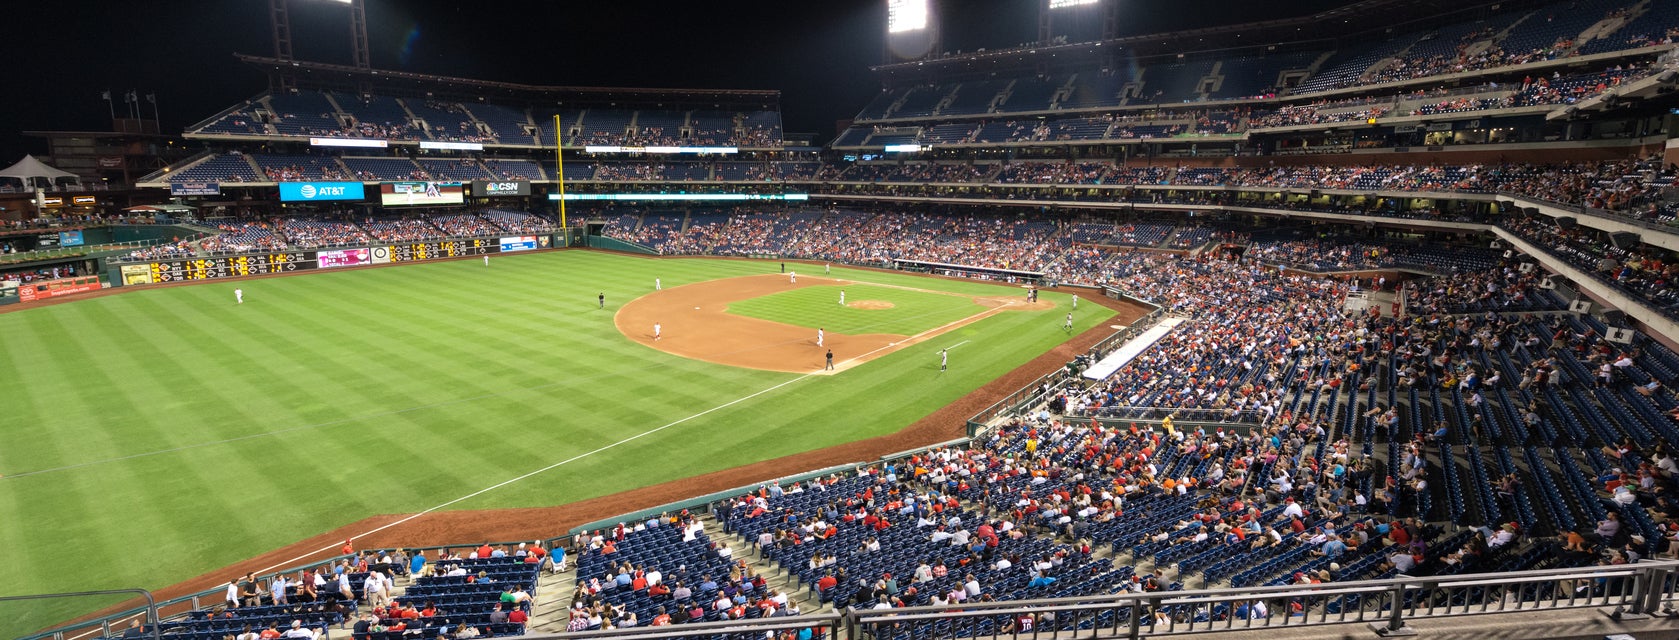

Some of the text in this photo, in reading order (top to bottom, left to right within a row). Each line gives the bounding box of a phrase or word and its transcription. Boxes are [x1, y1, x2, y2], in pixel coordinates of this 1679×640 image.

[499, 183, 518, 191] CSN
[319, 187, 345, 196] AT&T
[1023, 623, 1032, 631] 10
